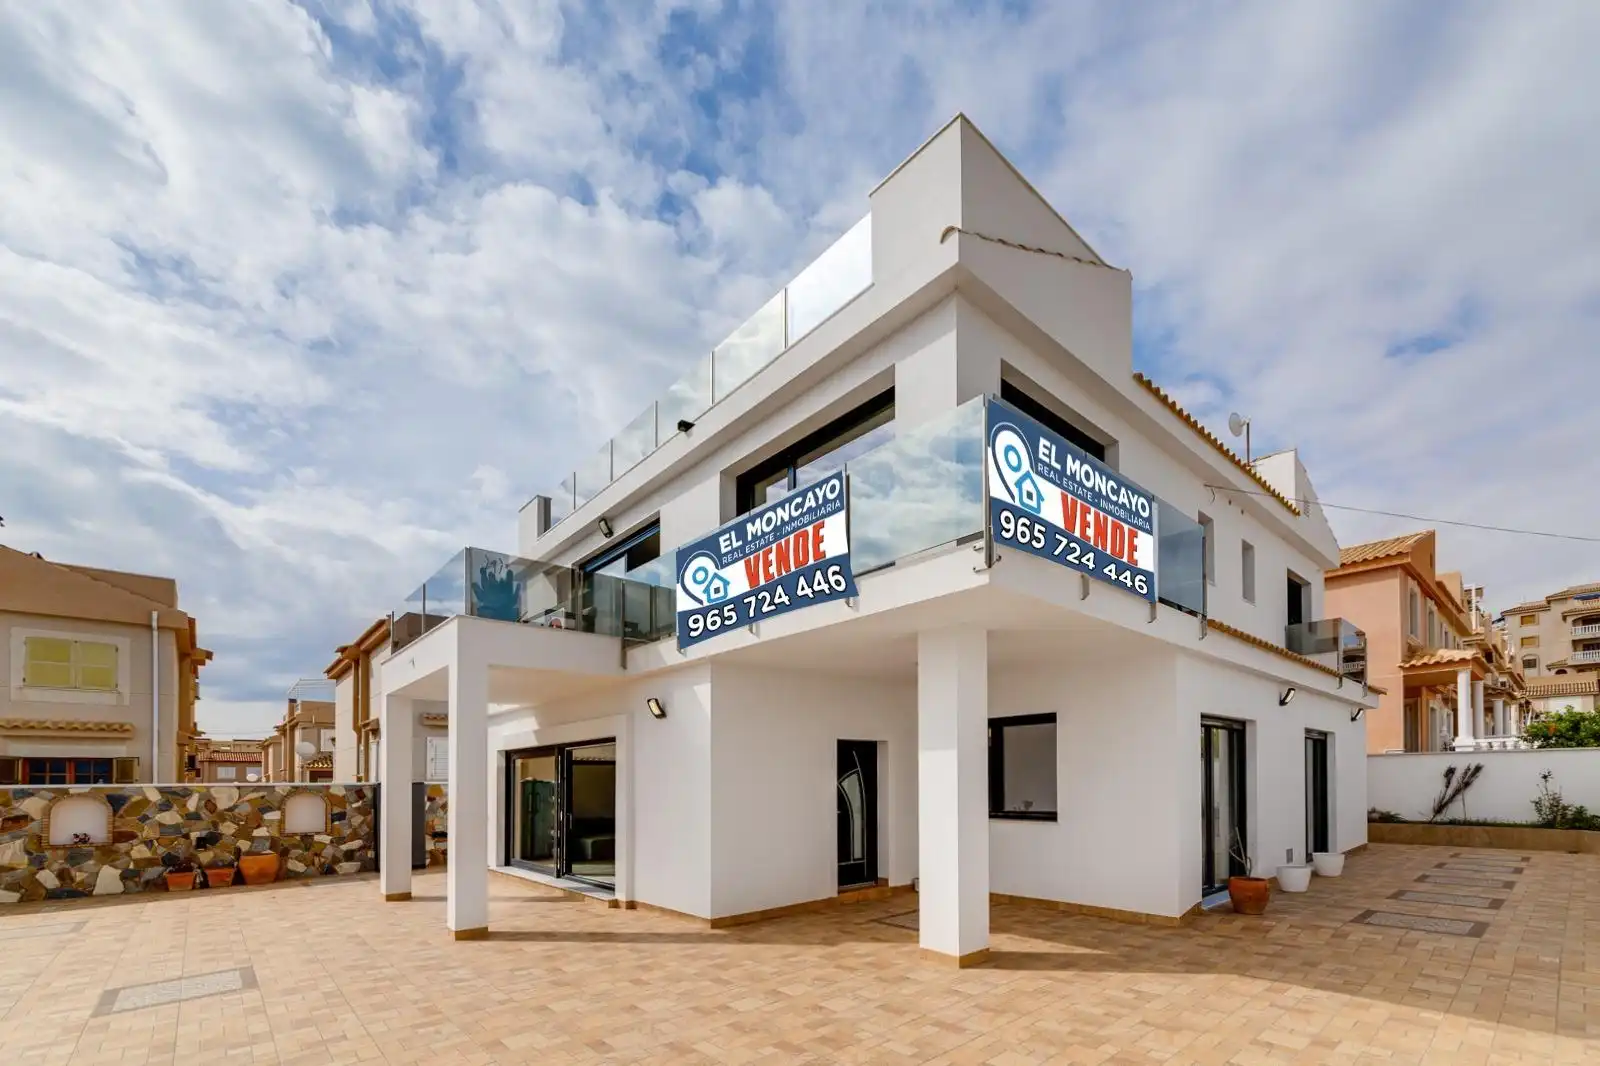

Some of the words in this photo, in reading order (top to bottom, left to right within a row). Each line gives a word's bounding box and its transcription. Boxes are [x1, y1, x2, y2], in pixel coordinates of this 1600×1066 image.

[1038, 437, 1061, 468] EL
[1067, 454, 1150, 517] MONCAYO
[1038, 466, 1060, 484] REAL
[1063, 480, 1093, 501] ESTATE
[1100, 500, 1150, 530] INMOBILIARIA
[719, 531, 742, 554] EL
[746, 478, 840, 539] MONCAYO
[723, 551, 743, 564] REAL
[746, 535, 774, 552] ESTATE
[783, 500, 841, 534] INMOBILIARIA
[999, 510, 1046, 548] 965
[1053, 534, 1096, 570] 724
[1102, 563, 1148, 594] 446
[1061, 491, 1138, 566] VENDE
[744, 519, 826, 589] VENDE
[688, 604, 737, 638] 965
[743, 586, 790, 618] 724
[796, 565, 846, 598] 446
